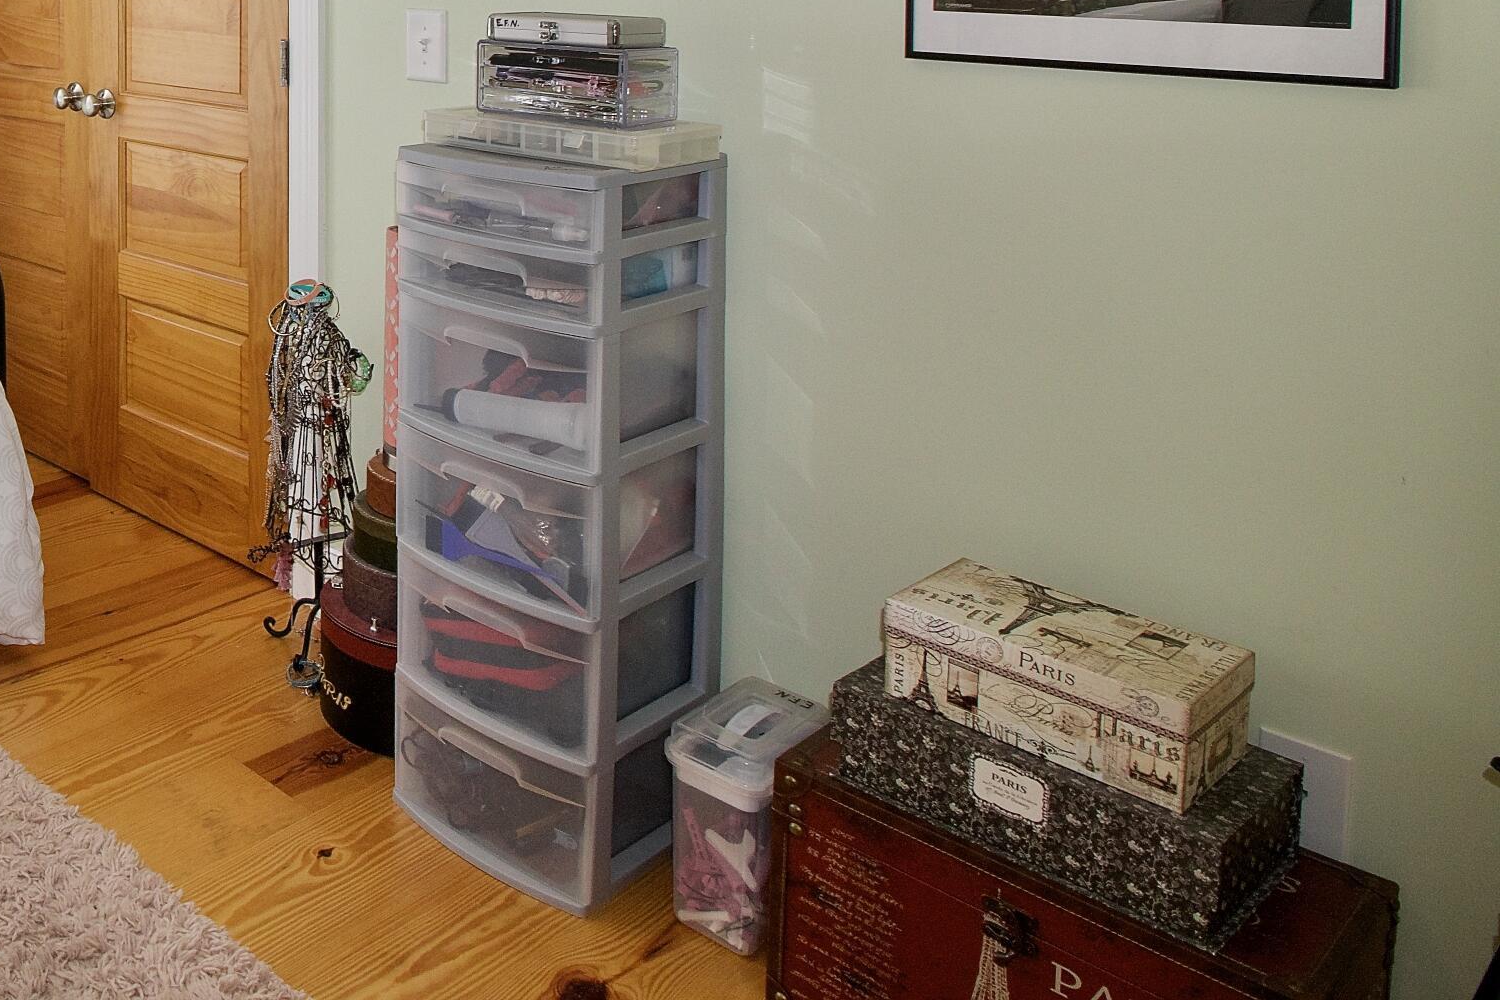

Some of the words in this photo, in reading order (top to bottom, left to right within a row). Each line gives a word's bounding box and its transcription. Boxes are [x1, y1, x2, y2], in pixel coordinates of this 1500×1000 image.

[319, 652, 352, 710] RIS
[893, 653, 905, 695] PARIS
[1018, 649, 1076, 687] PARIS
[991, 772, 1028, 794] PARIS
